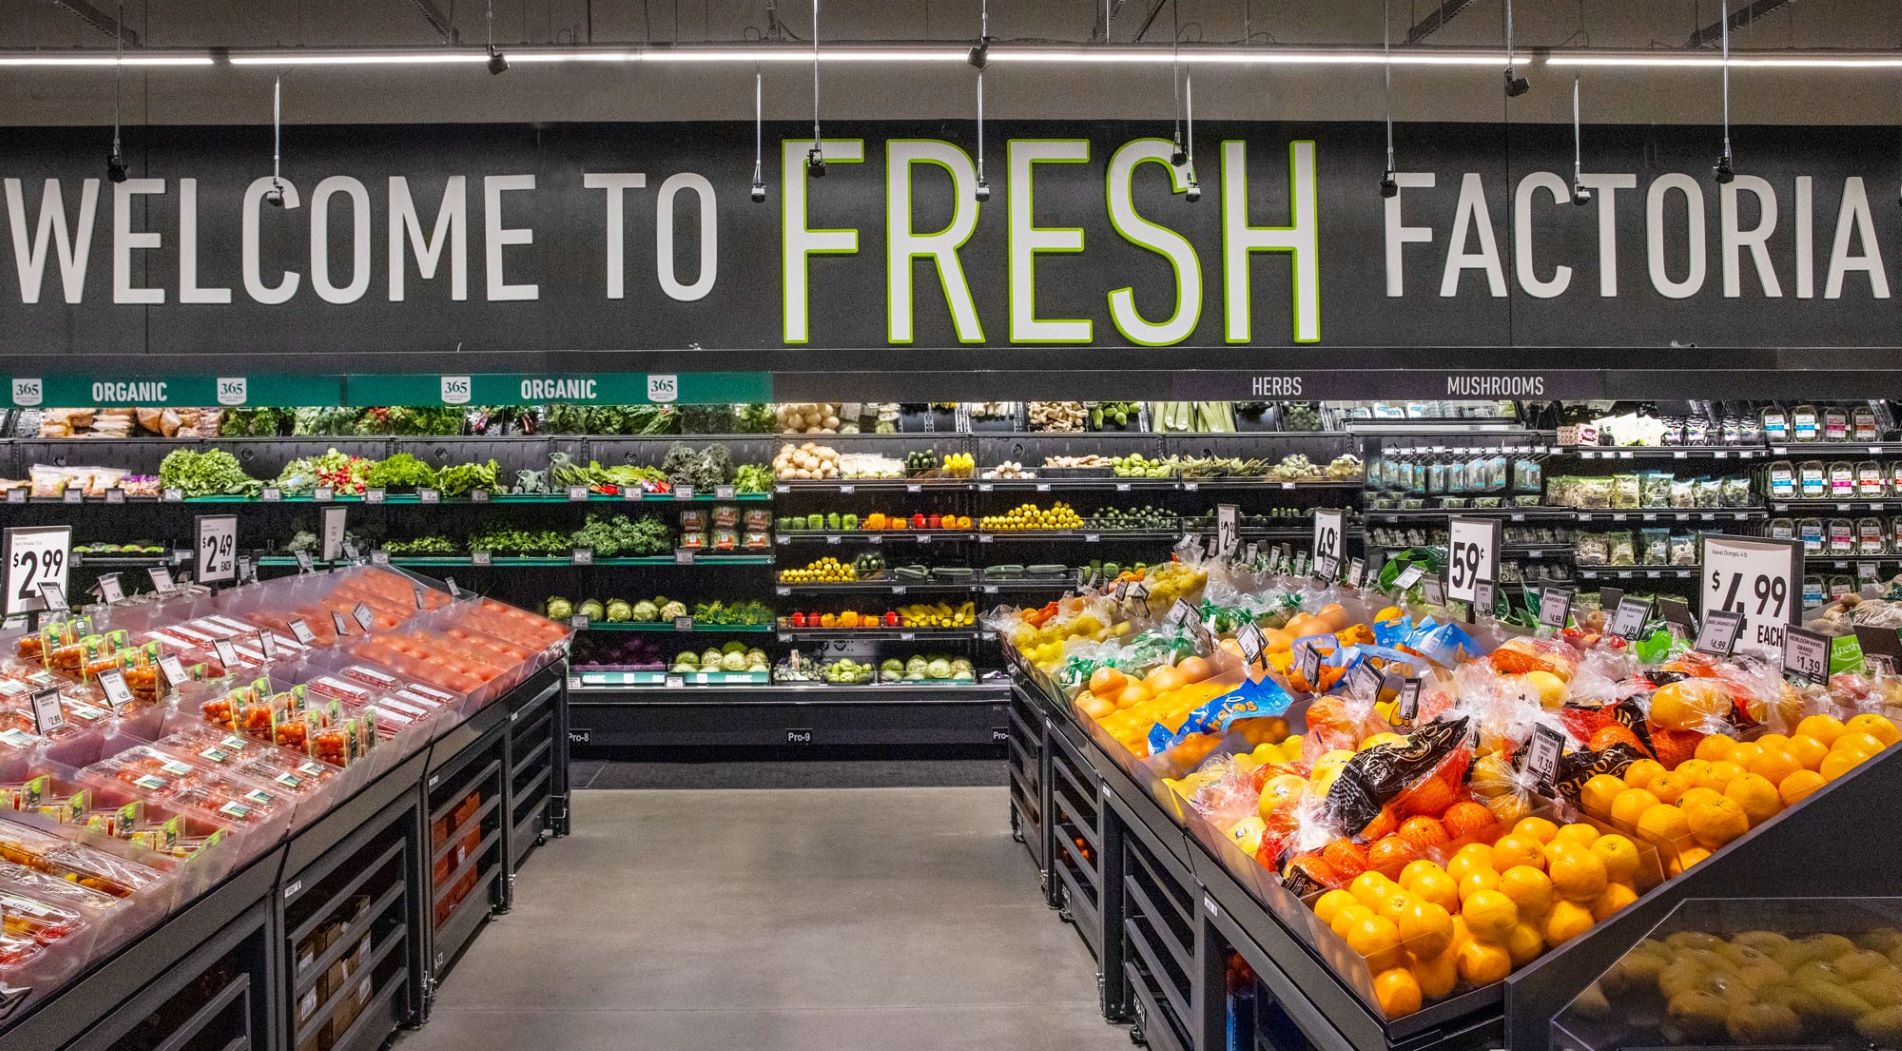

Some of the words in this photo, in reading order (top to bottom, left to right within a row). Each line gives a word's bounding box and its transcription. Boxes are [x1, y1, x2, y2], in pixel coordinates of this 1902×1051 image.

[4, 174, 540, 304] WELCOME
[583, 172, 718, 302] TO
[781, 138, 1321, 346] FRESH
[1384, 171, 1891, 299] FACTORIA
[16, 382, 39, 396] 365
[92, 382, 168, 402] ORGANIC
[220, 381, 244, 395] 365
[444, 380, 468, 394] 365
[520, 379, 598, 400] ORGANIC
[650, 379, 674, 393] 365
[1252, 376, 1302, 396] HERBS
[1447, 376, 1545, 396] MUSHROOMS
[1757, 624, 1783, 647] EACH
[1796, 655, 1821, 673] $1.39
[788, 732, 811, 742] Pro-9
